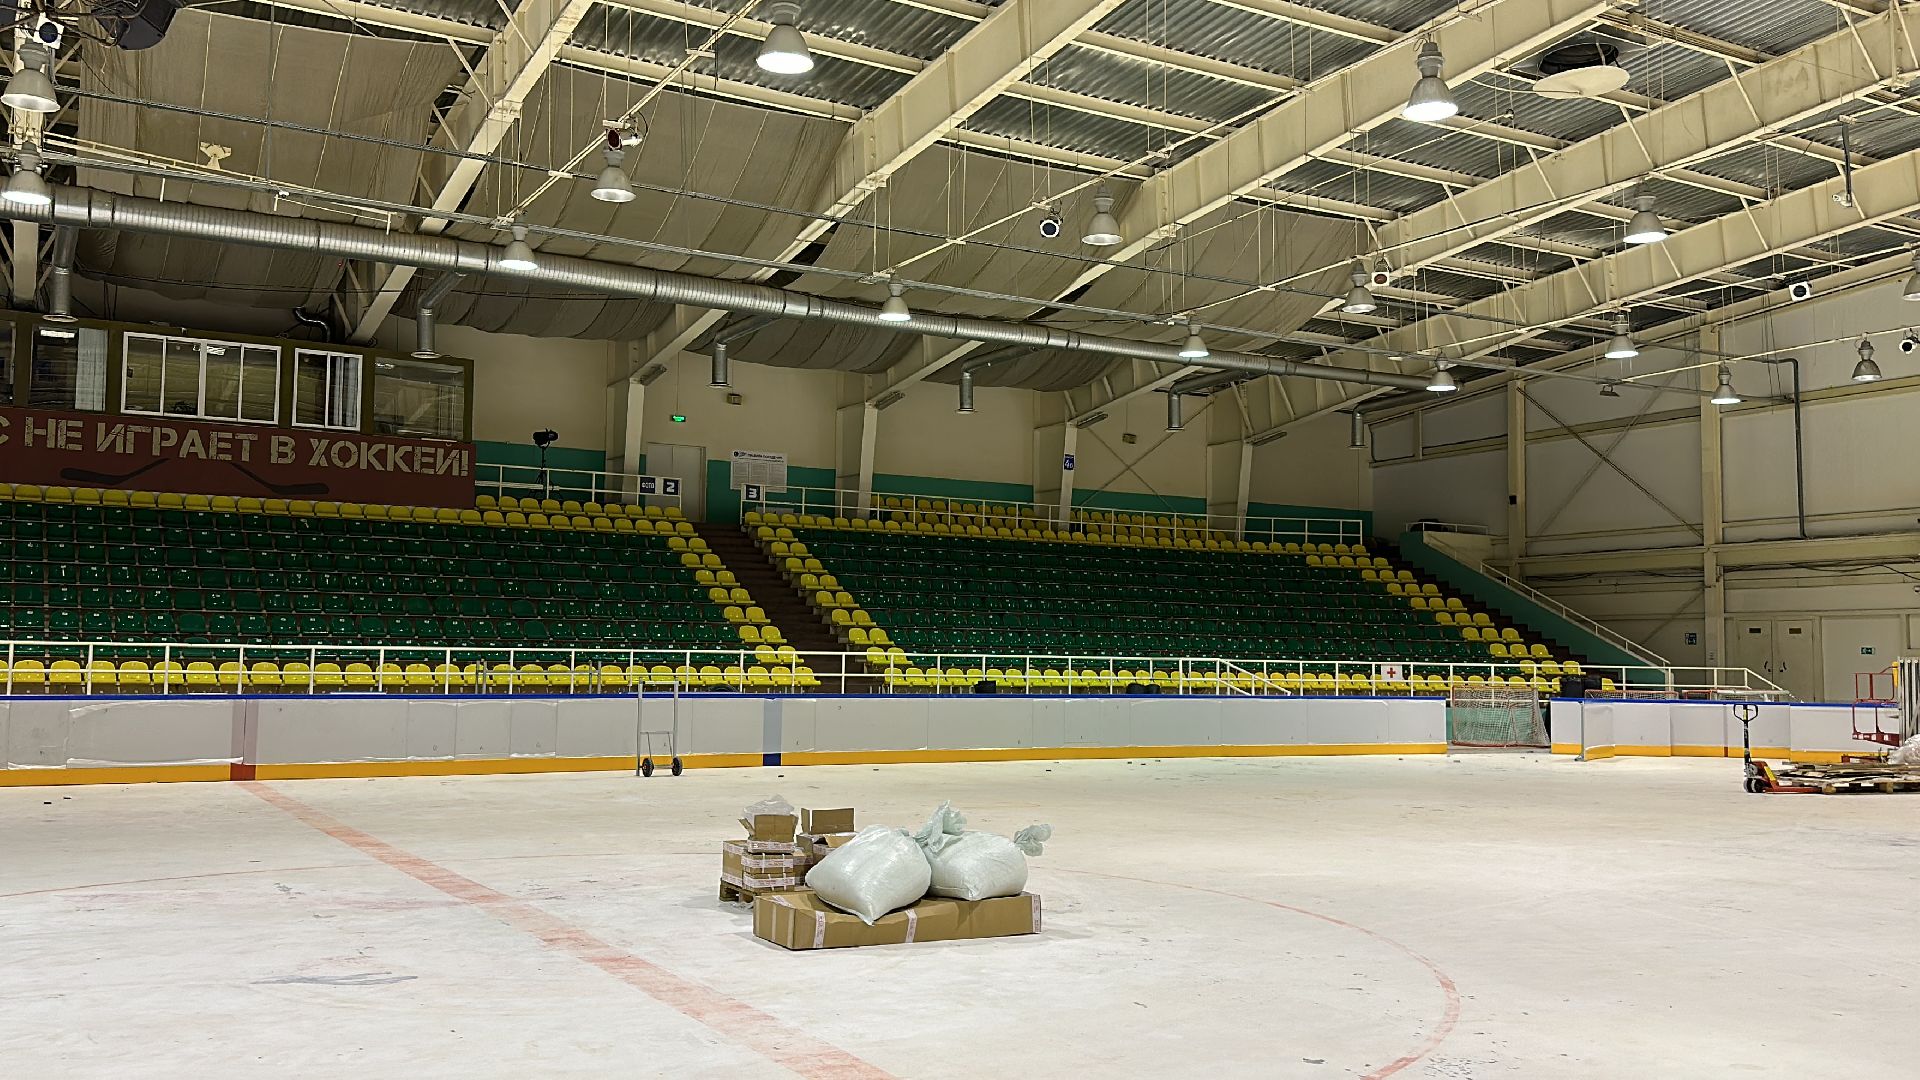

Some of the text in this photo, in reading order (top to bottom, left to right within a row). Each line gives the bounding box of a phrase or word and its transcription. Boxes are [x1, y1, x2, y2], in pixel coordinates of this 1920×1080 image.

[24, 416, 84, 451] НЕ
[97, 422, 258, 462] ИГРАЕТ
[270, 435, 296, 464] В
[308, 437, 469, 477] ХОККЕЙ!
[666, 481, 675, 493] 2
[748, 487, 757, 499] 3
